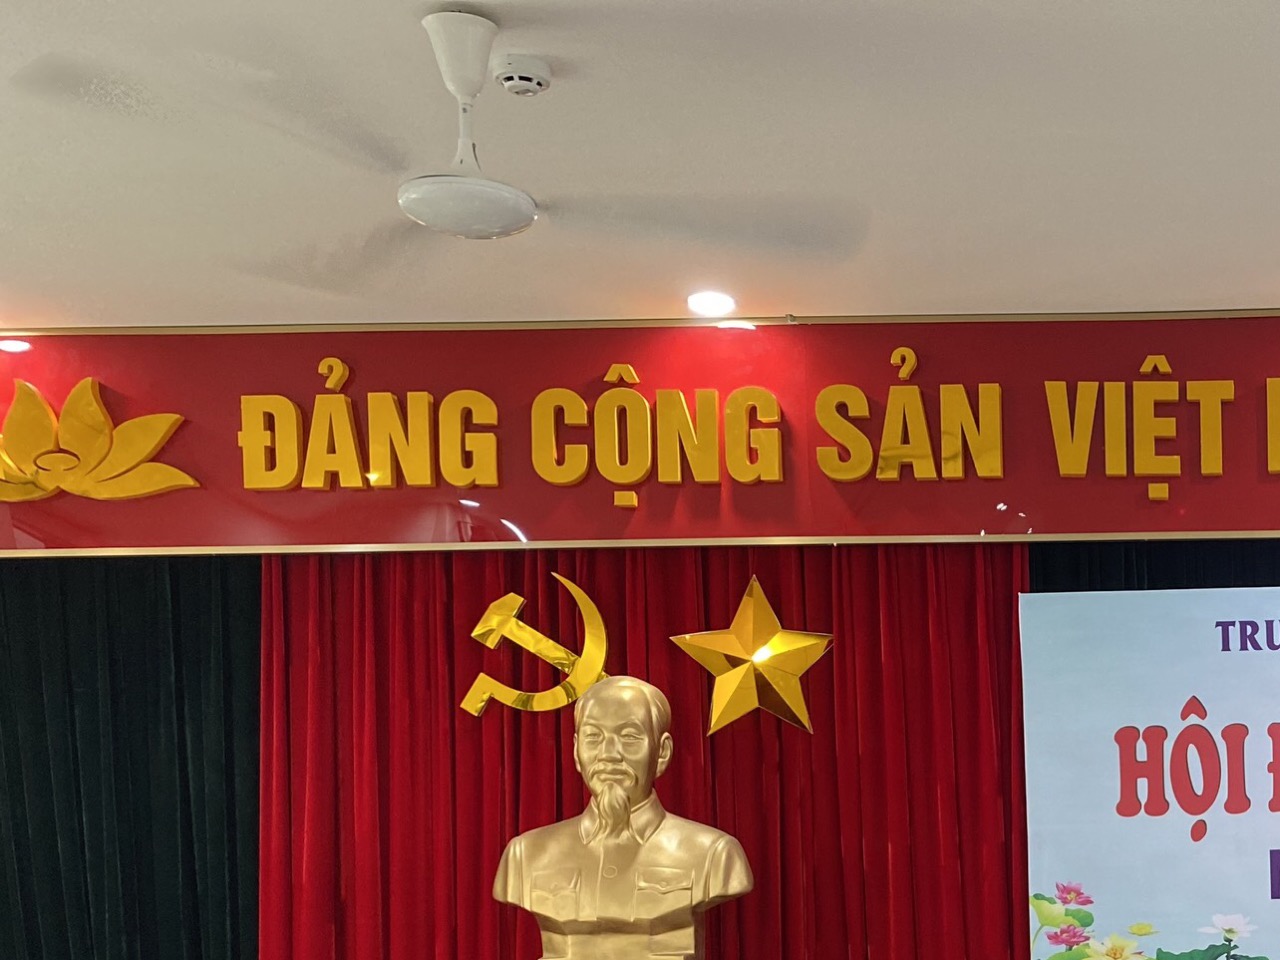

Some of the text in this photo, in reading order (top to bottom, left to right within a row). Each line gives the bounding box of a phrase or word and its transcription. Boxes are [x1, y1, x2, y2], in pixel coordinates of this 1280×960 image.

[238, 357, 500, 491] ĐẢNG
[530, 363, 783, 508] CỘNG
[815, 347, 1004, 481] SẢN
[1044, 354, 1235, 500] VIỆT
[1114, 695, 1251, 842] HỘI
